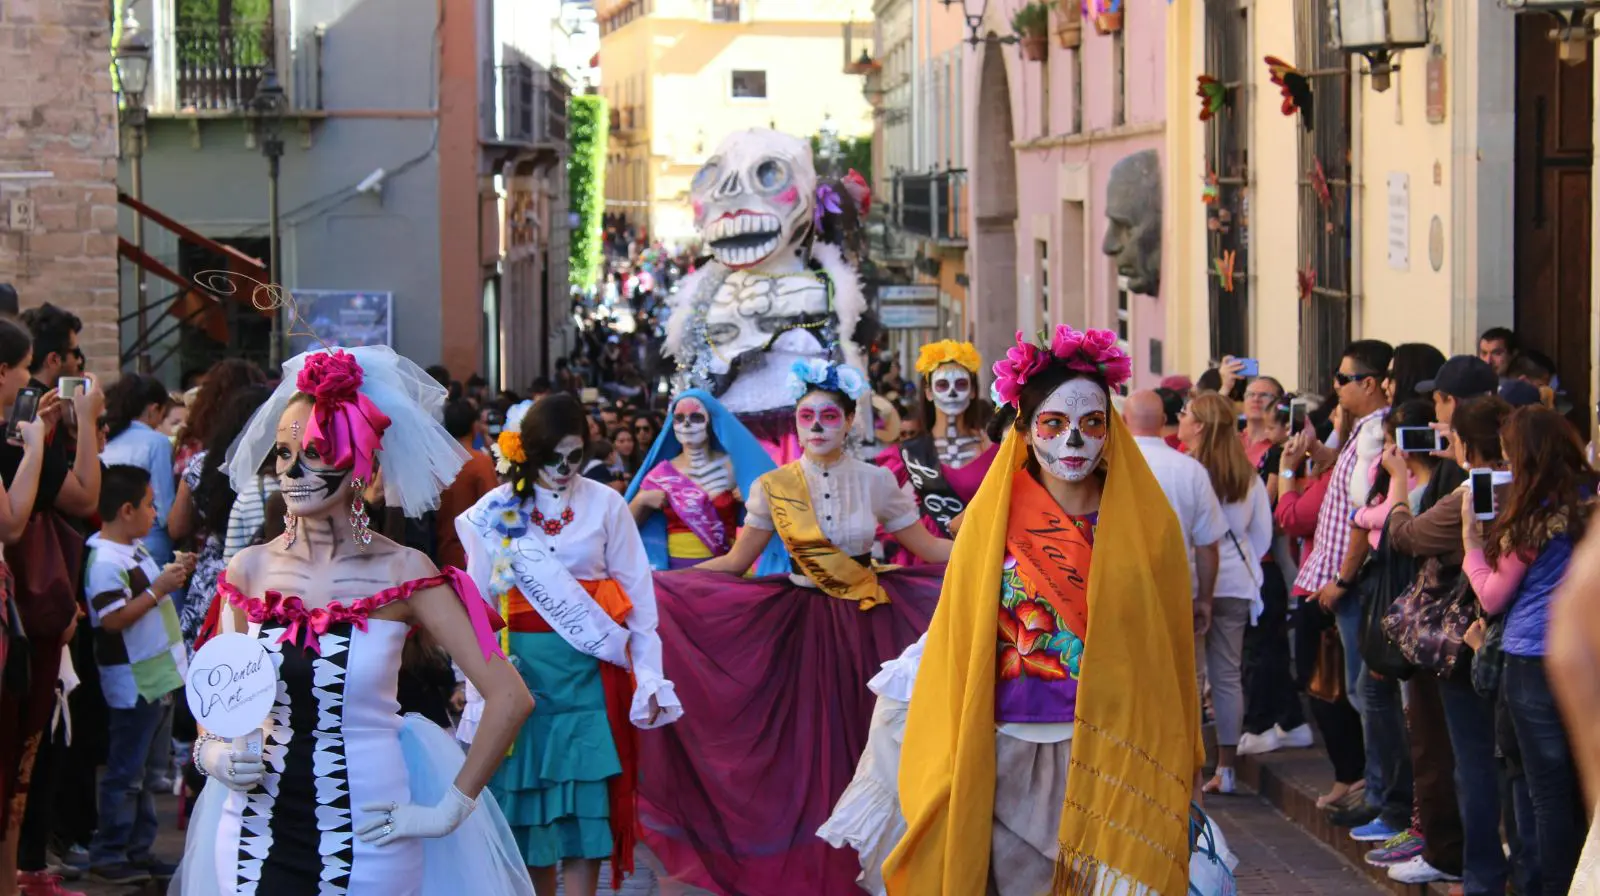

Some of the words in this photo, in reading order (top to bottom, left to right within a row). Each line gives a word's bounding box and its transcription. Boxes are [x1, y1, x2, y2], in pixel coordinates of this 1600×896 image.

[902, 448, 939, 490] La
[763, 480, 810, 530] Las
[1025, 511, 1087, 590] Van
[207, 649, 265, 692] Dental
[209, 686, 243, 713] Art
